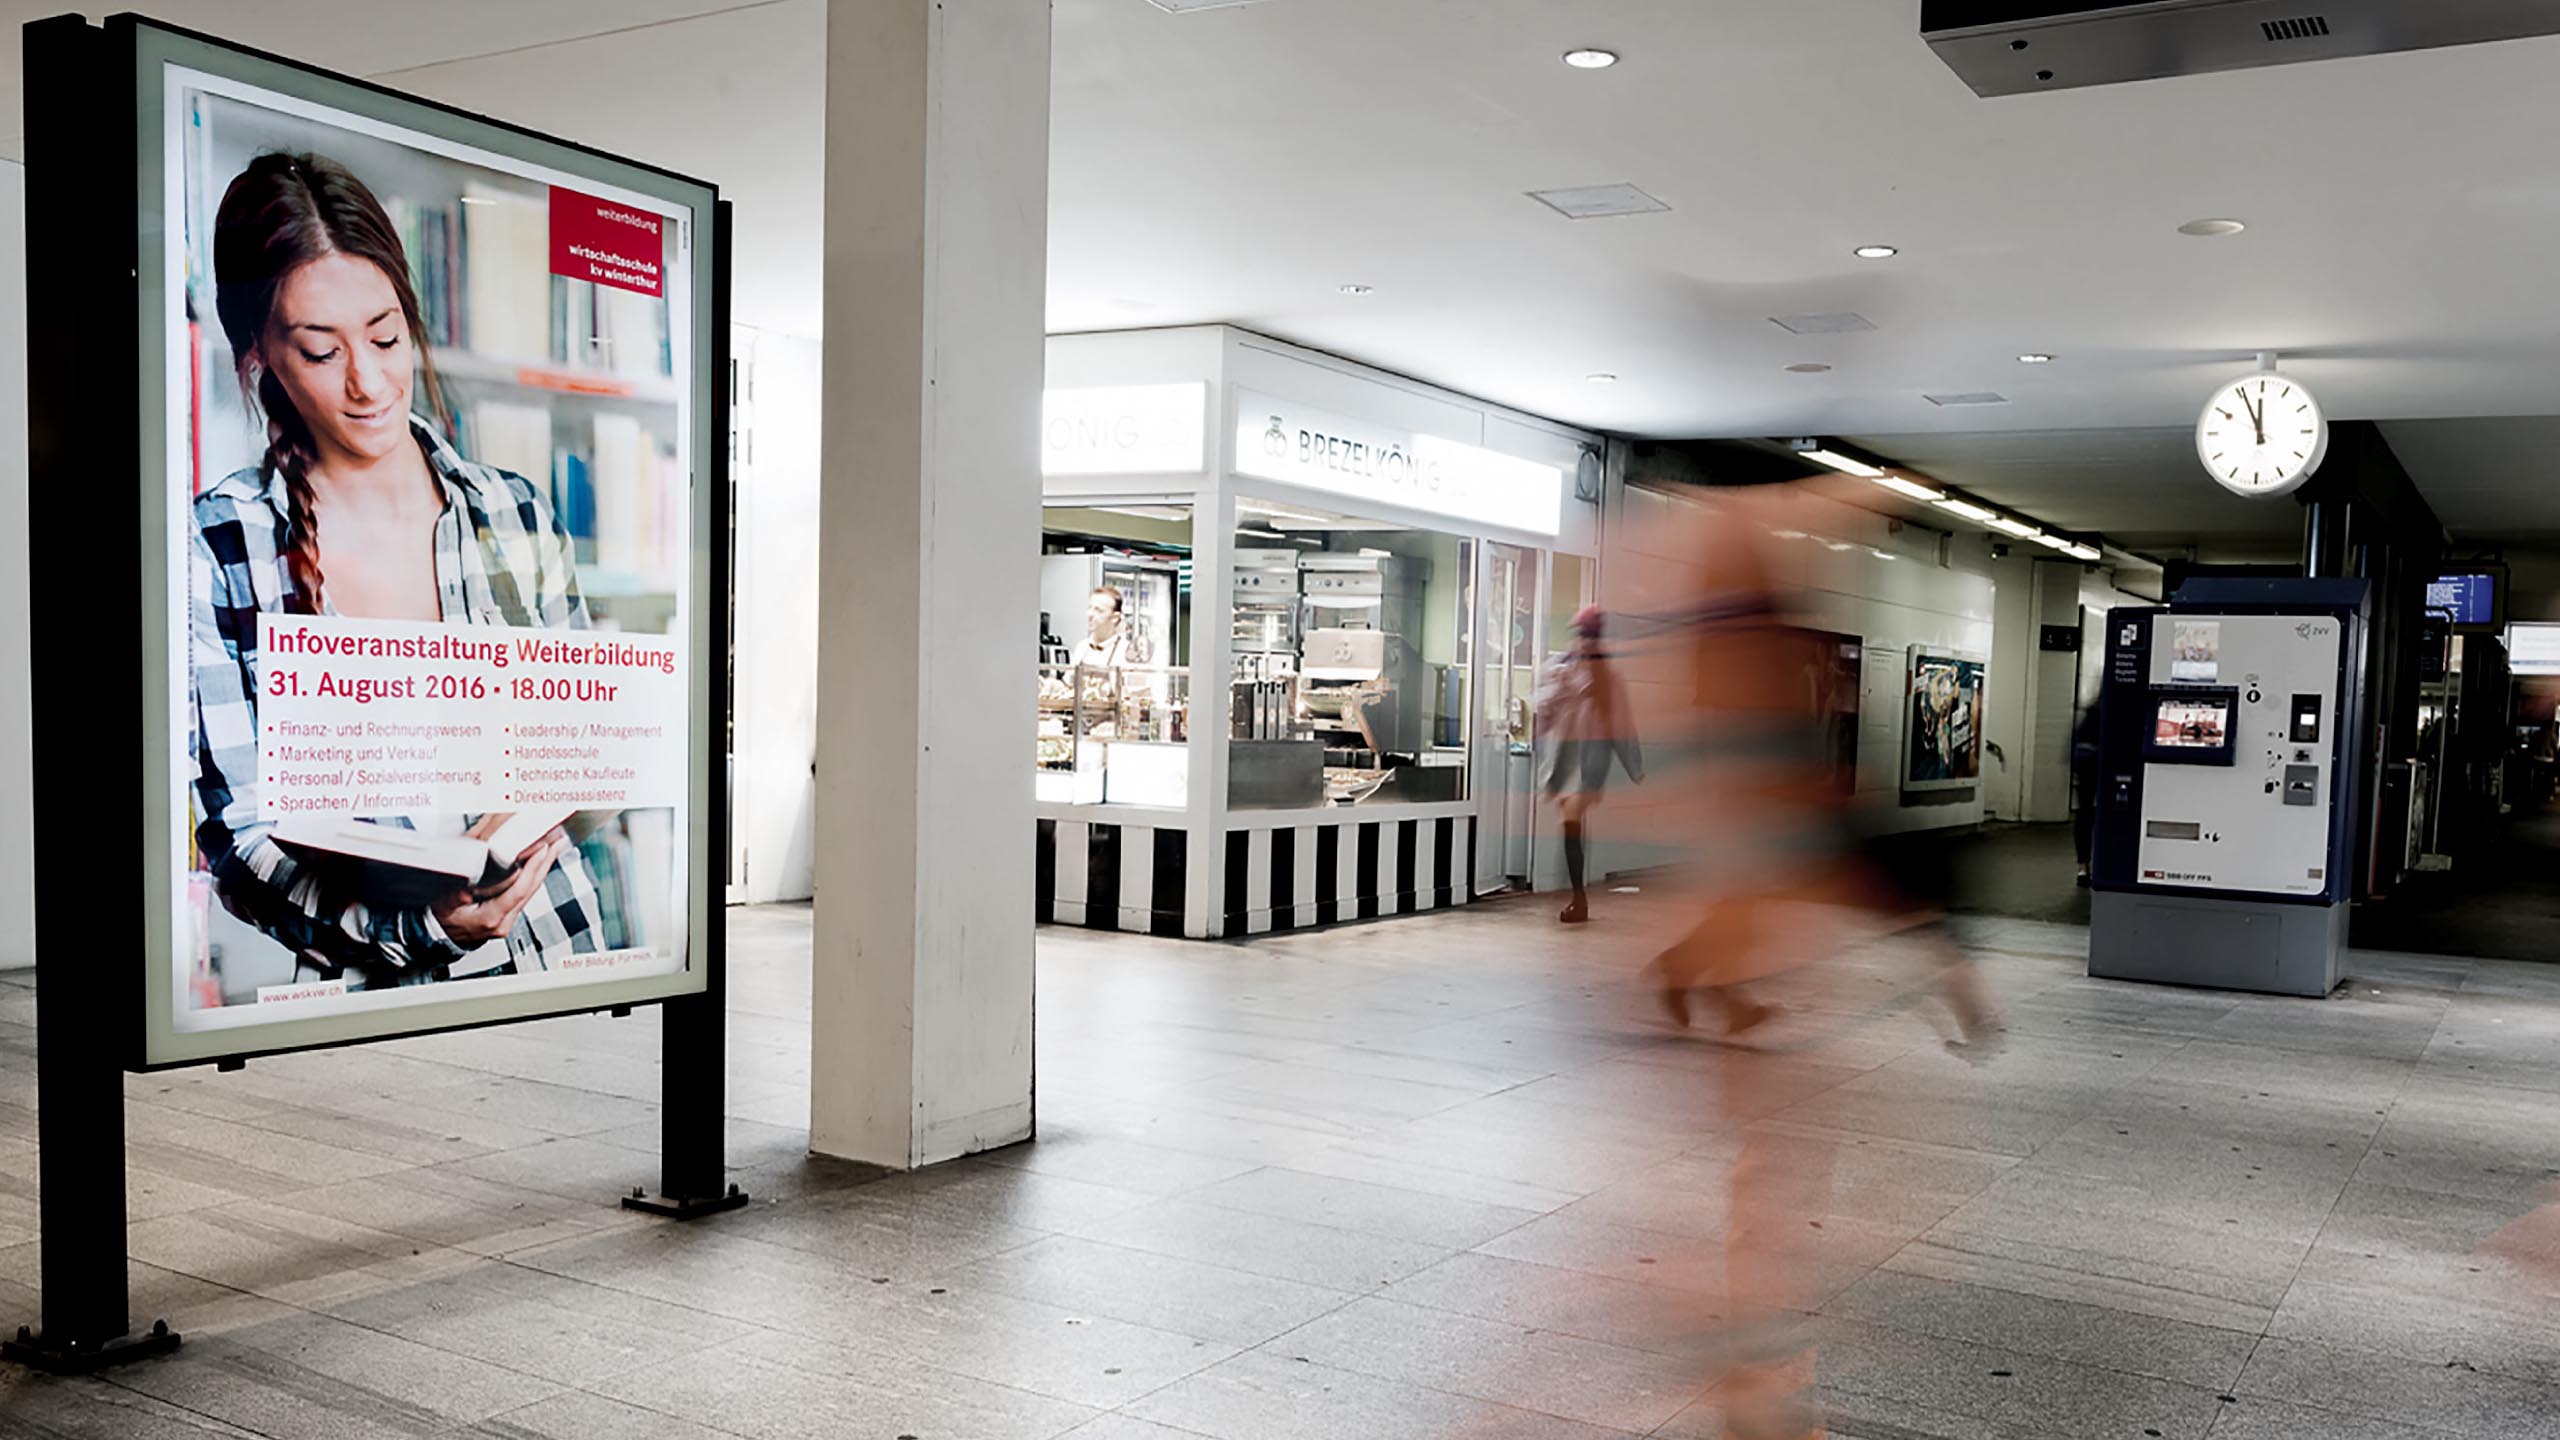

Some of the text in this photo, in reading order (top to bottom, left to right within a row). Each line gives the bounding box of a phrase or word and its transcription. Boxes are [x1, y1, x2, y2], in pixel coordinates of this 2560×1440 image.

[597, 207, 657, 234] weiterbildung
[569, 244, 657, 275] wirtschaftsschule
[590, 263, 657, 289] kv winterthur
[1299, 428, 1442, 491] BREZELKÖNIG
[268, 626, 675, 674] Infoveranstaltung Weiterbildung
[268, 671, 618, 704] 31. August 2016 18.00 Uhr
[279, 720, 482, 740] Finanz- und Rechnungswesen
[514, 723, 578, 739] Leadership
[590, 723, 662, 740] Management
[279, 745, 438, 764] Marketing und Verkauf
[514, 746, 599, 760] Handelsschule
[279, 769, 343, 786] Personal
[357, 768, 482, 786] Sozialversicherung
[514, 766, 636, 782] Technische Kaufleute
[279, 795, 348, 813] Sprachen
[363, 793, 432, 809] Informatik
[514, 788, 626, 804] Direktionsassistenz
